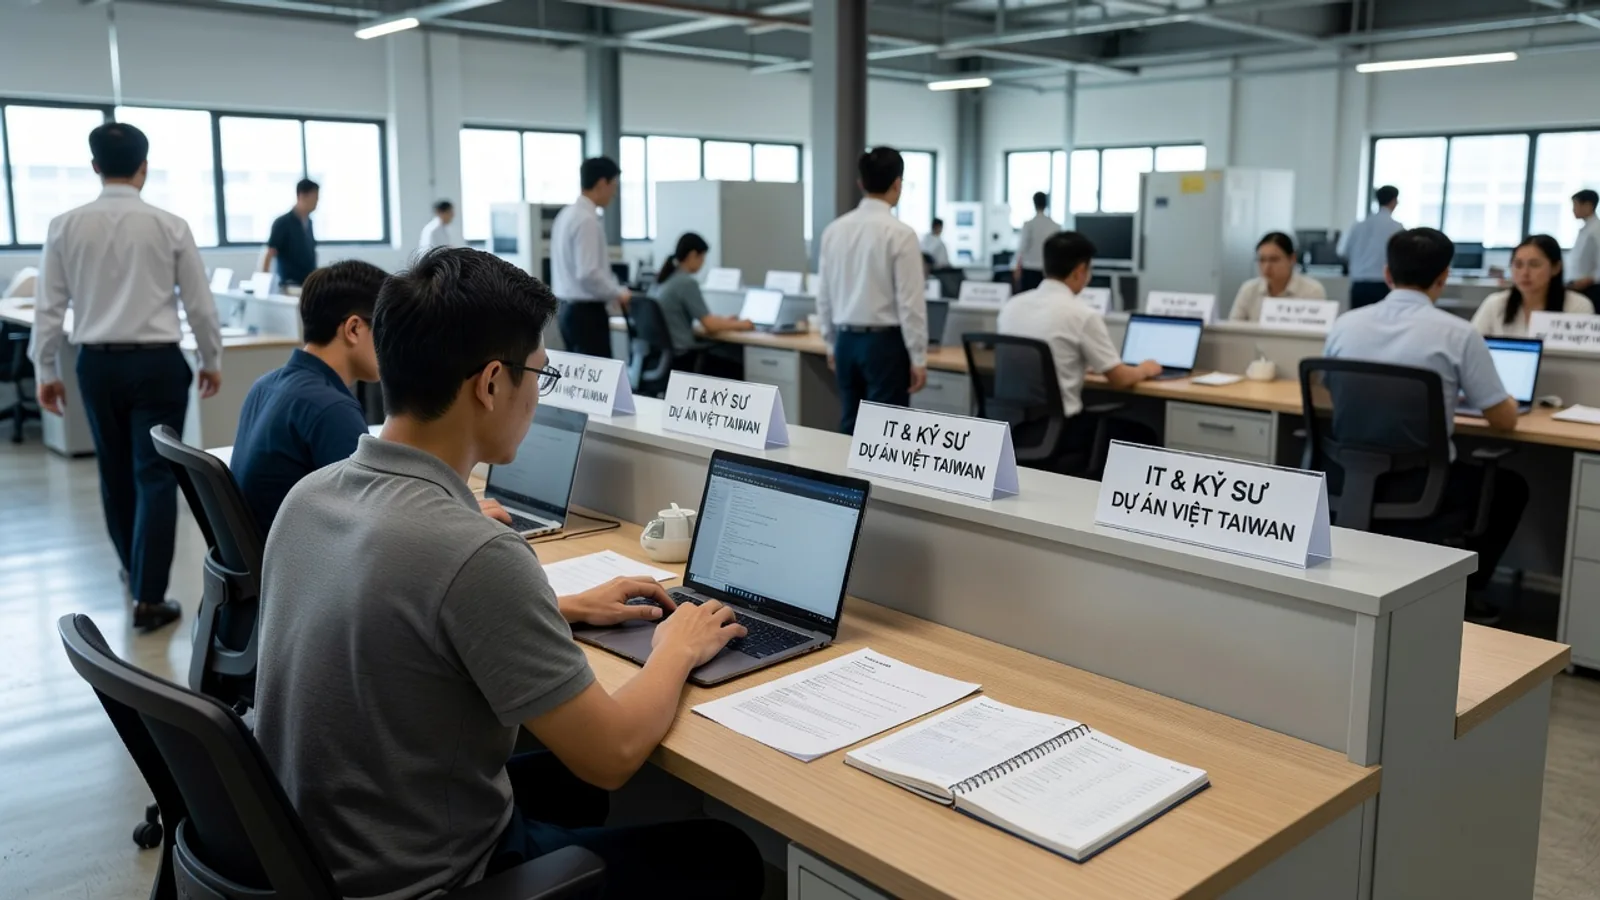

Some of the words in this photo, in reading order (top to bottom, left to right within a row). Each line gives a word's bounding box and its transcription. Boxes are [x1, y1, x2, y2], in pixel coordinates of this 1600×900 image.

[686, 386, 699, 401] IT
[699, 388, 708, 404] &
[730, 393, 751, 410] SƯ
[883, 420, 898, 438] IT
[901, 423, 911, 441] &
[942, 430, 971, 451] SƯ
[933, 456, 986, 481] TAIWAN
[1145, 465, 1167, 486] IT
[1170, 469, 1186, 492] &
[1231, 480, 1270, 505] SƯ
[1111, 491, 1140, 514] DỰ
[1140, 492, 1168, 517] ÁN
[1172, 501, 1214, 528] VIỆT
[1218, 510, 1296, 543] TAIWAN
